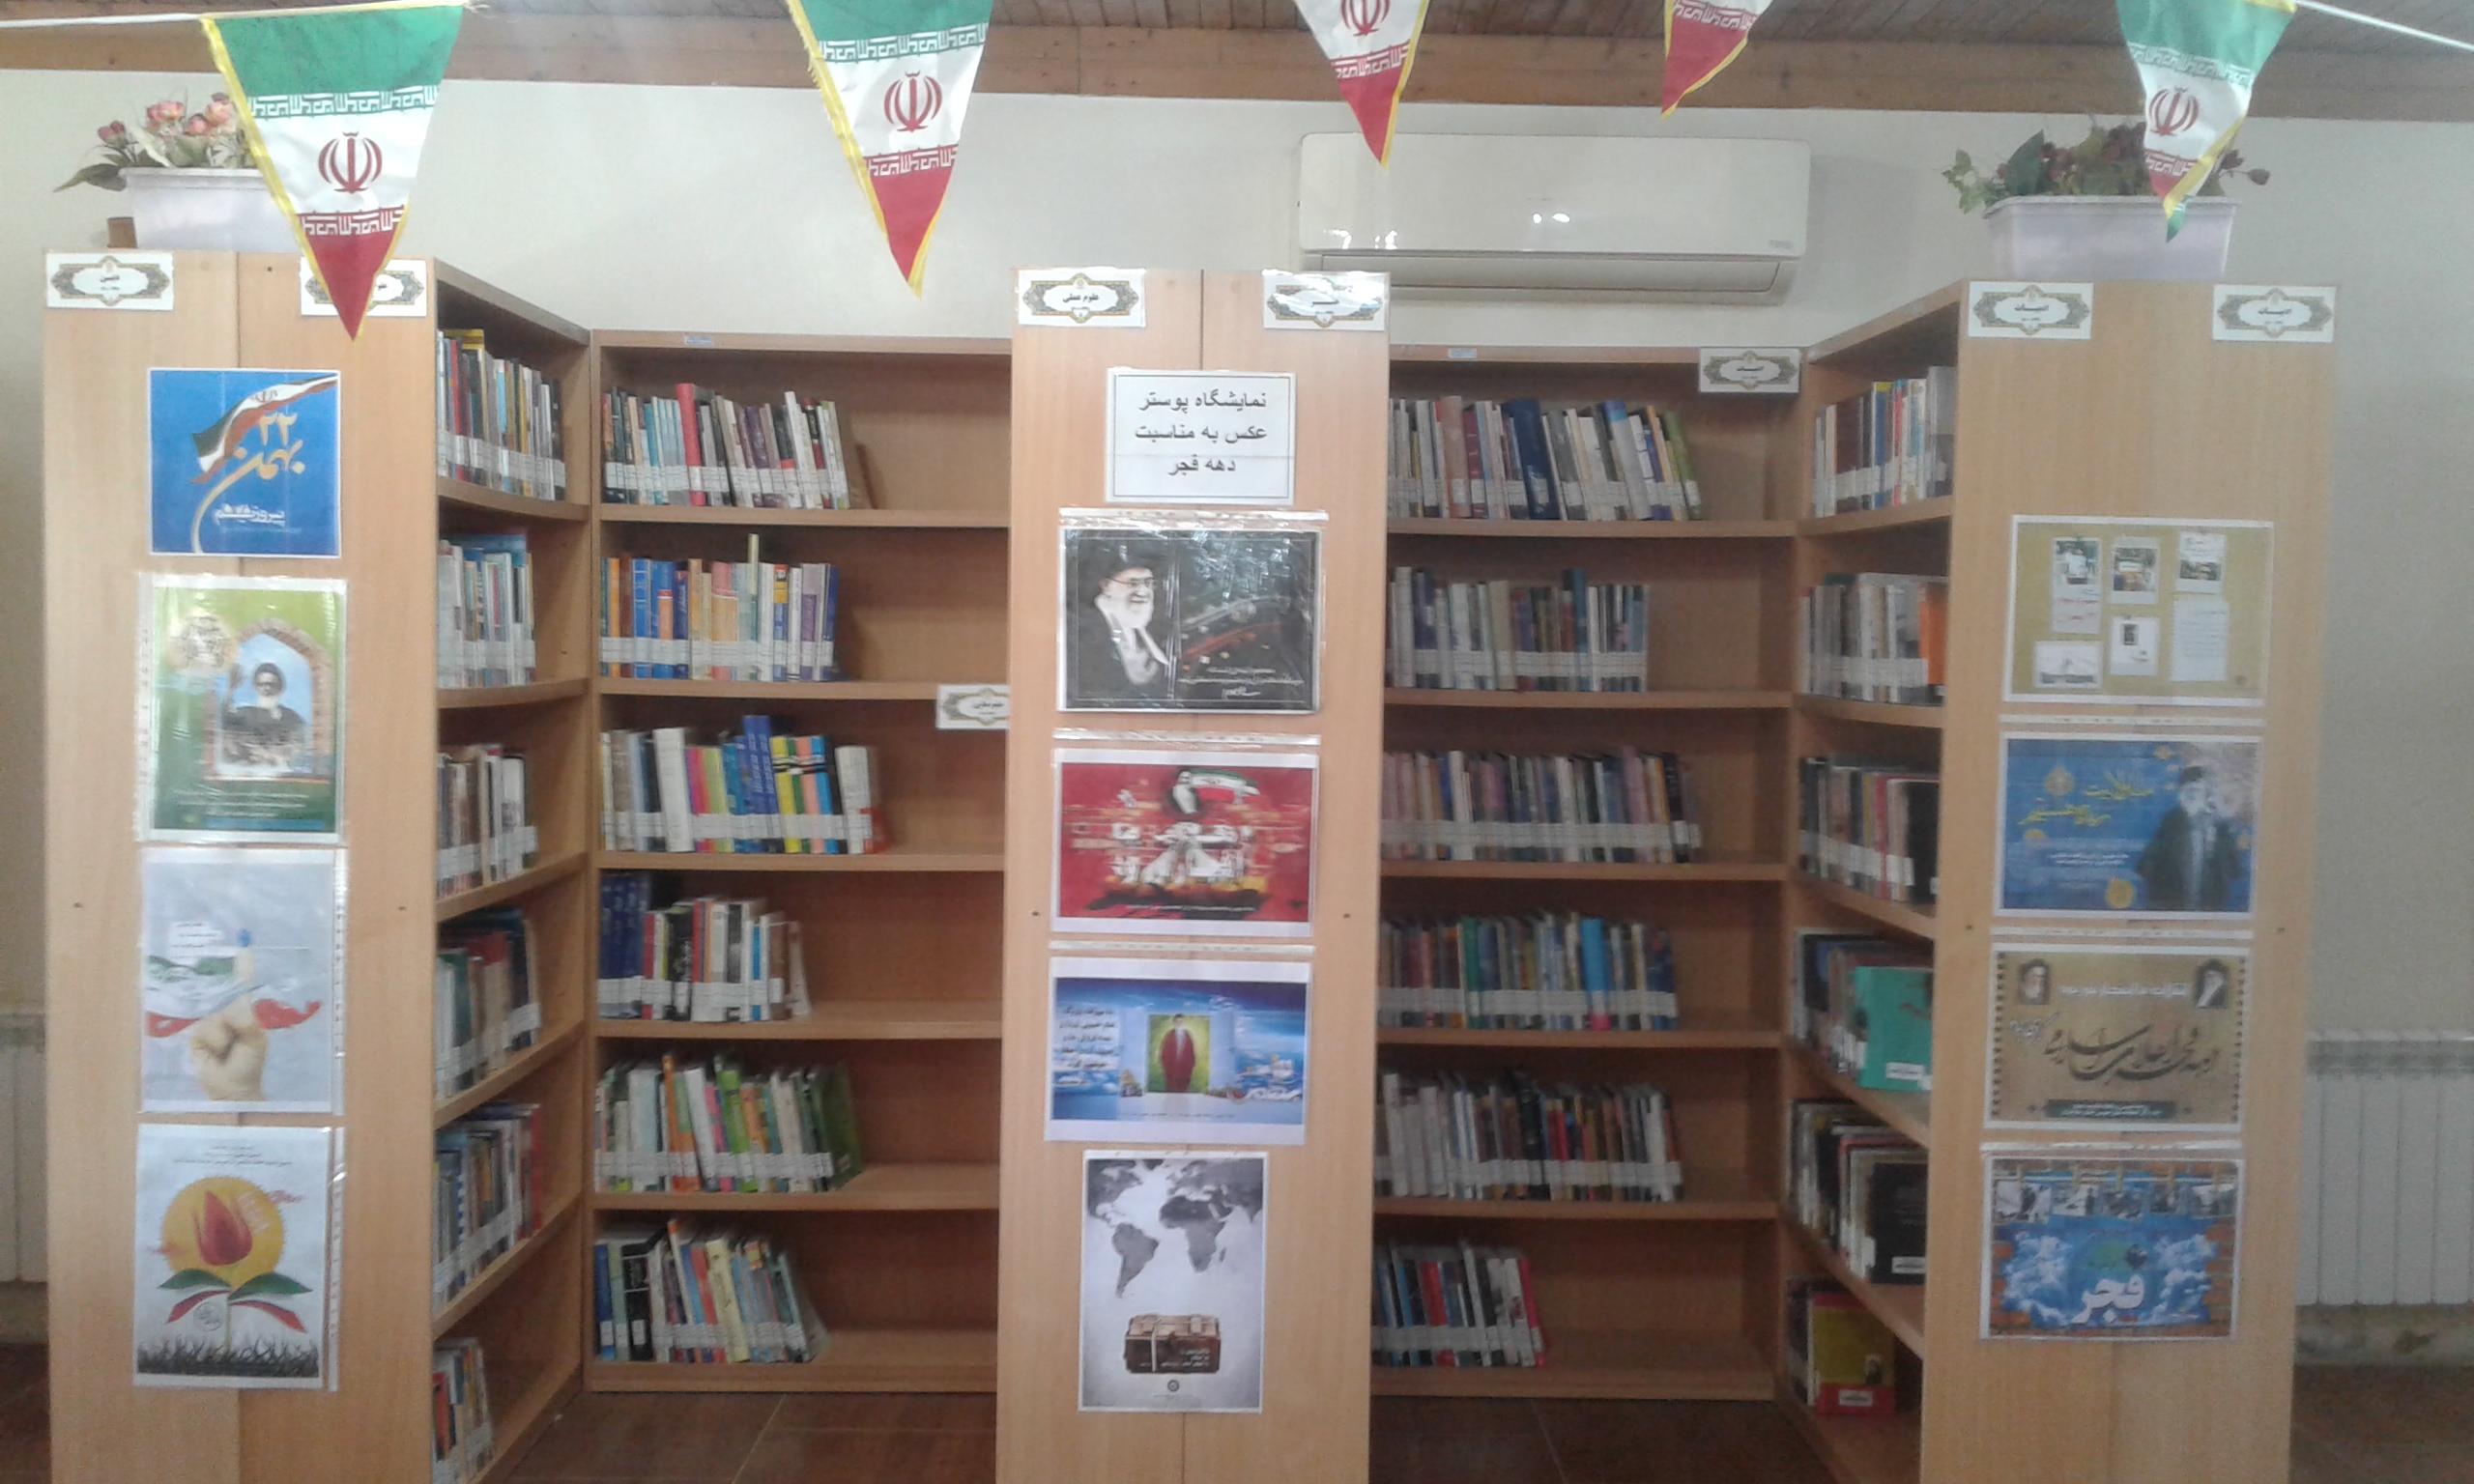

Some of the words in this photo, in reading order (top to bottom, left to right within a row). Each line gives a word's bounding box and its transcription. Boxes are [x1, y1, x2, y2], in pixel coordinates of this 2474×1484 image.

[1137, 390, 1190, 414] پوستر
[1194, 388, 1267, 413] نمایشگاه
[257, 412, 299, 447] ۲۲
[1134, 423, 1196, 443] مناسبت
[1200, 425, 1220, 444] به
[1224, 425, 1268, 444] عکس
[1166, 454, 1199, 476] فجر
[1204, 457, 1236, 473] دهه
[2070, 1272, 2146, 1326] فجر
